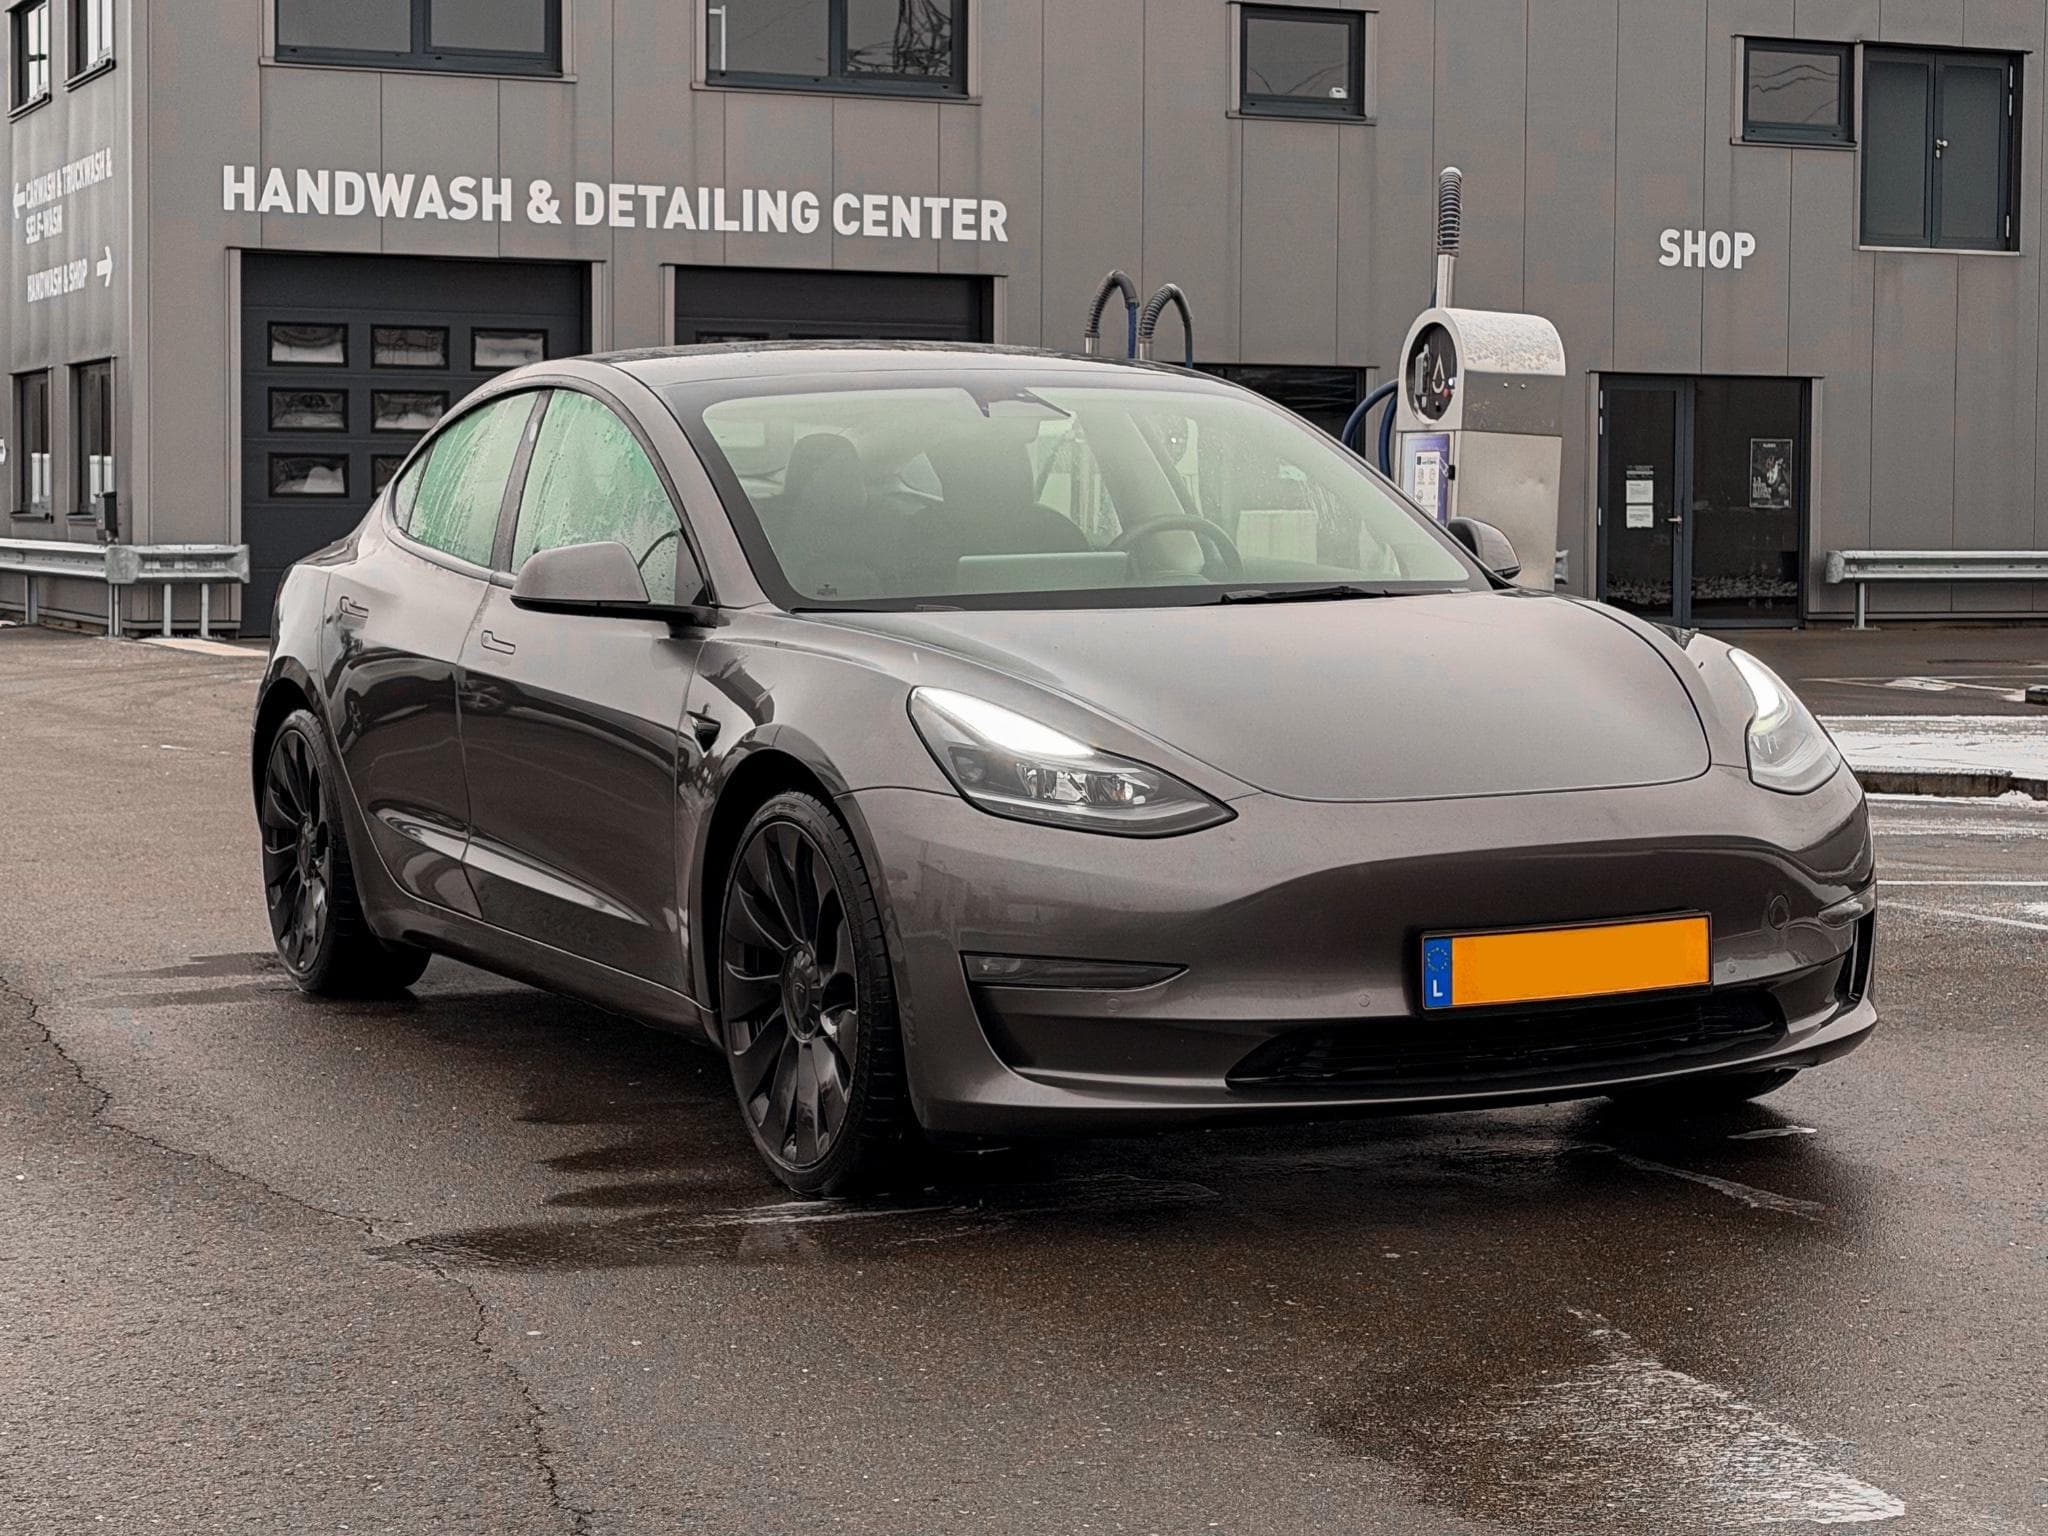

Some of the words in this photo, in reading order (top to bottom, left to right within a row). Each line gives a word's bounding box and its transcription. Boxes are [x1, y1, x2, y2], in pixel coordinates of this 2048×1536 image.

[62, 149, 105, 195] TRUCKWASH
[223, 165, 512, 222] HANDWASH
[526, 179, 562, 225] &
[575, 182, 820, 234] DETAILING
[833, 193, 1009, 242] CENTER
[1658, 228, 1756, 270] SHOP
[1432, 979, 1443, 997] L
